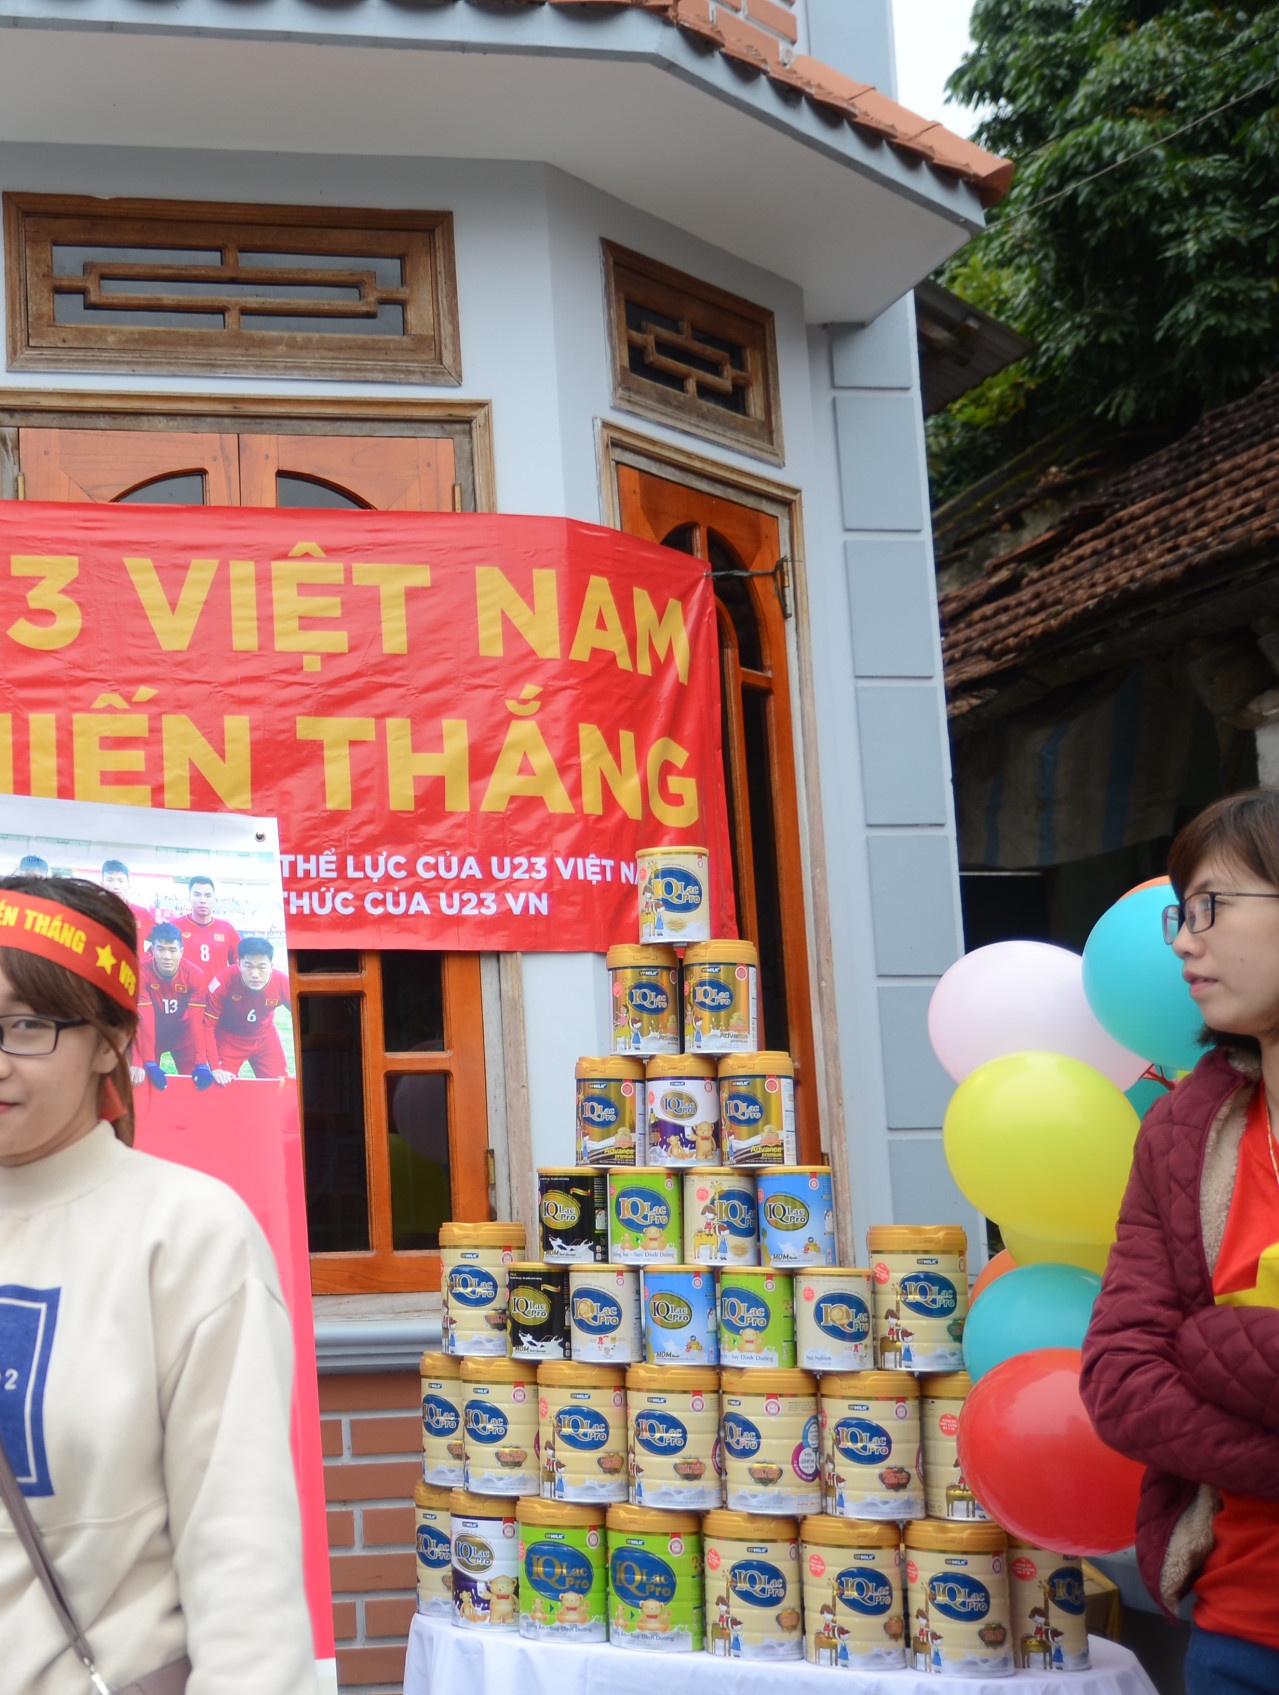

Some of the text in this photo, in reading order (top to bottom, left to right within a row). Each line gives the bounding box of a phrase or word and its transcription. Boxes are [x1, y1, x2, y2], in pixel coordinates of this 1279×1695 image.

[122, 541, 431, 672] VIỆT
[475, 565, 690, 686] NAM
[296, 684, 700, 828] THẮNG
[280, 848, 337, 878] THỂ
[347, 851, 407, 882] LỰC
[415, 851, 483, 880] CỦA
[490, 856, 548, 880] U23
[554, 854, 615, 885] VIỆT
[363, 886, 431, 915] CỦA
[439, 892, 497, 915] U23
[505, 892, 548, 915] VN
[24, 914, 87, 955] THẮNG
[200, 944, 210, 962] 8
[162, 998, 178, 1014] 13
[246, 1009, 257, 1022] 6
